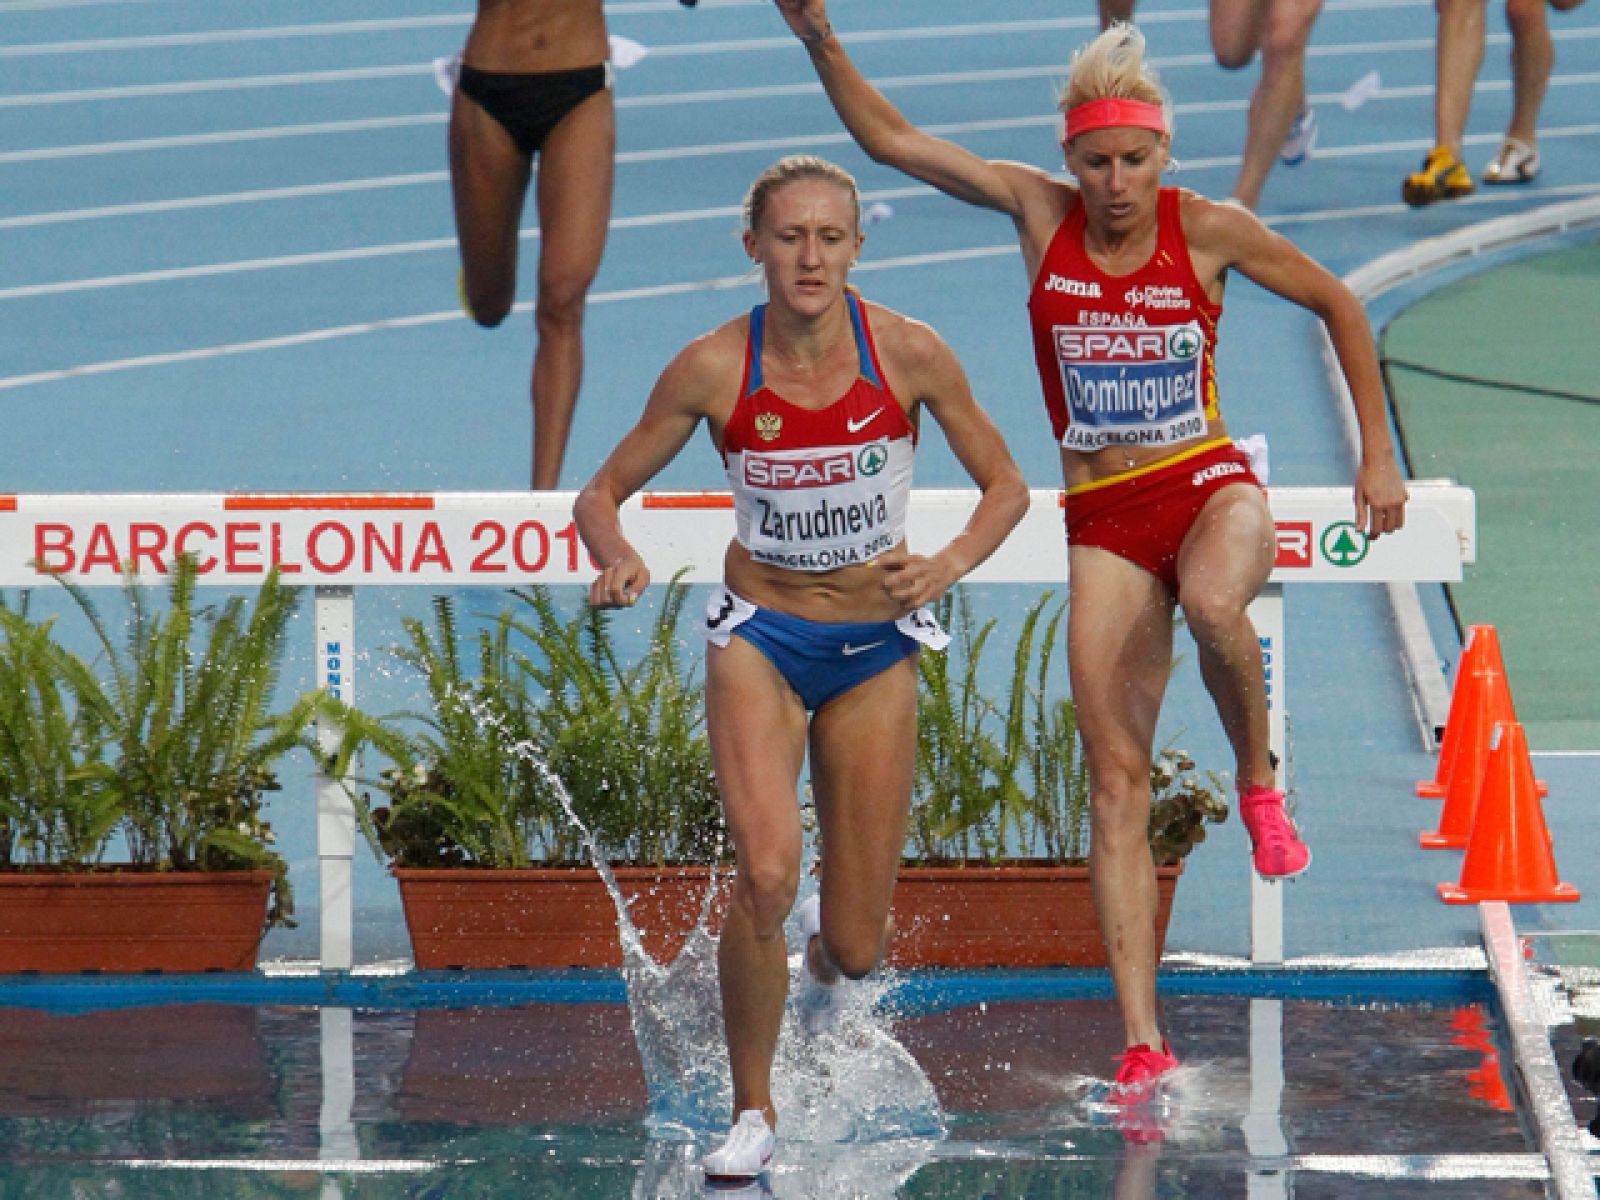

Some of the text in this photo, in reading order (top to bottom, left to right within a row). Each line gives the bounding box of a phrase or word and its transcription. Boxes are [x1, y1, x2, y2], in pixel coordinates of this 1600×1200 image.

[1059, 334, 1164, 358] SPAR
[1068, 367, 1195, 419] Domínguez
[1169, 417, 1203, 441] 2010
[744, 459, 852, 485] SPAR
[757, 495, 888, 541] Zarudneva
[34, 519, 603, 575] BARCELONA 201
